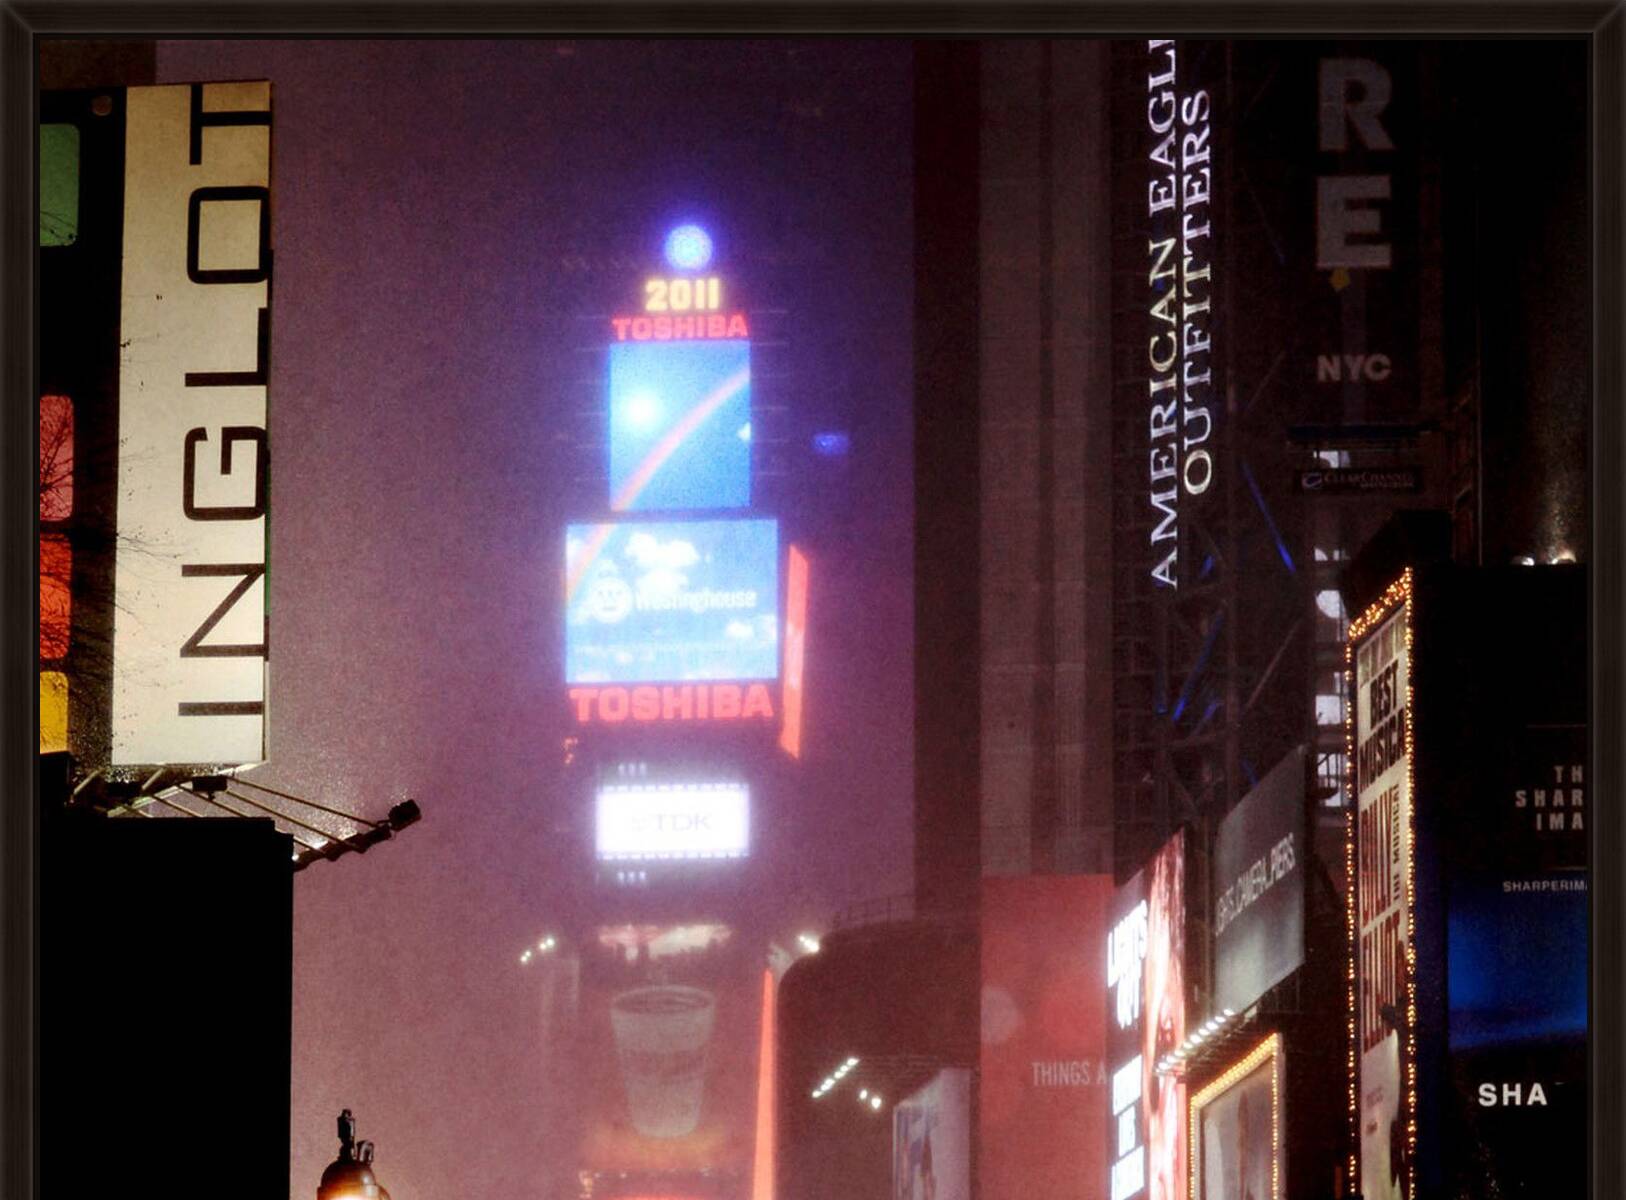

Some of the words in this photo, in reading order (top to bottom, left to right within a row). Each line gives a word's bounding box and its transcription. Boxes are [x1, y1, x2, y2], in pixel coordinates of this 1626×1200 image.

[644, 278, 721, 311] 2011
[1180, 89, 1212, 495] OUTFITTERS
[611, 313, 749, 341] TOSHIBA
[1316, 353, 1392, 383] NYC
[177, 81, 271, 718] INGLOT
[1149, 236, 1178, 591] AMERICAN
[568, 685, 774, 723] TOSHIBA
[1513, 787, 1585, 809] SHAR
[655, 814, 713, 832] TDK
[1536, 811, 1585, 832] IMA
[1031, 1060, 1090, 1087] THINGS
[1477, 1082, 1549, 1107] SHA
